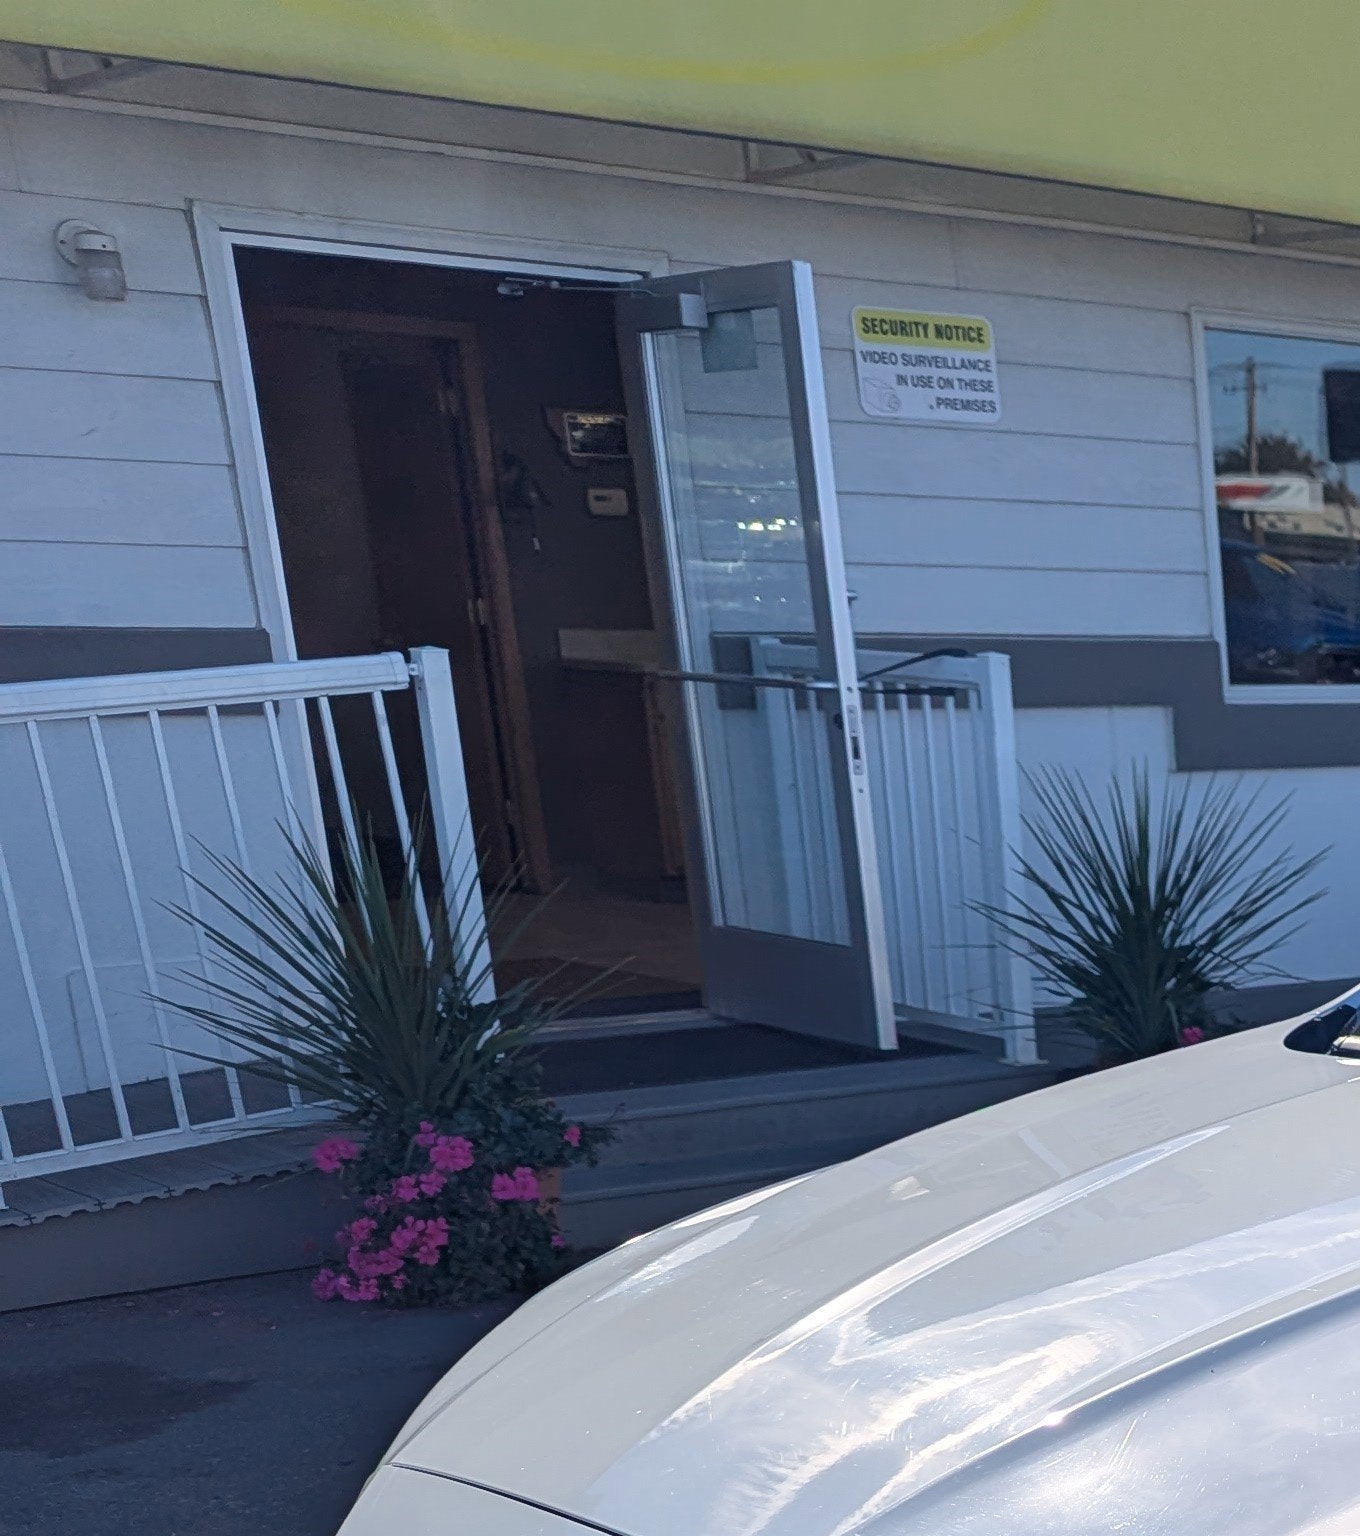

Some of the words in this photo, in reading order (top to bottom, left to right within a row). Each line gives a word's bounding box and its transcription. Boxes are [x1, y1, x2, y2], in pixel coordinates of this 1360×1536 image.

[861, 316, 929, 339] SECURITY
[934, 323, 985, 344] NOTICE
[860, 350, 898, 366] VIDEO
[902, 352, 992, 373] SURVEILLANCE
[896, 373, 909, 387] IN
[912, 374, 934, 389] USE
[937, 376, 954, 390] ON
[958, 377, 995, 393] THESE
[936, 397, 997, 414] PREMISES
